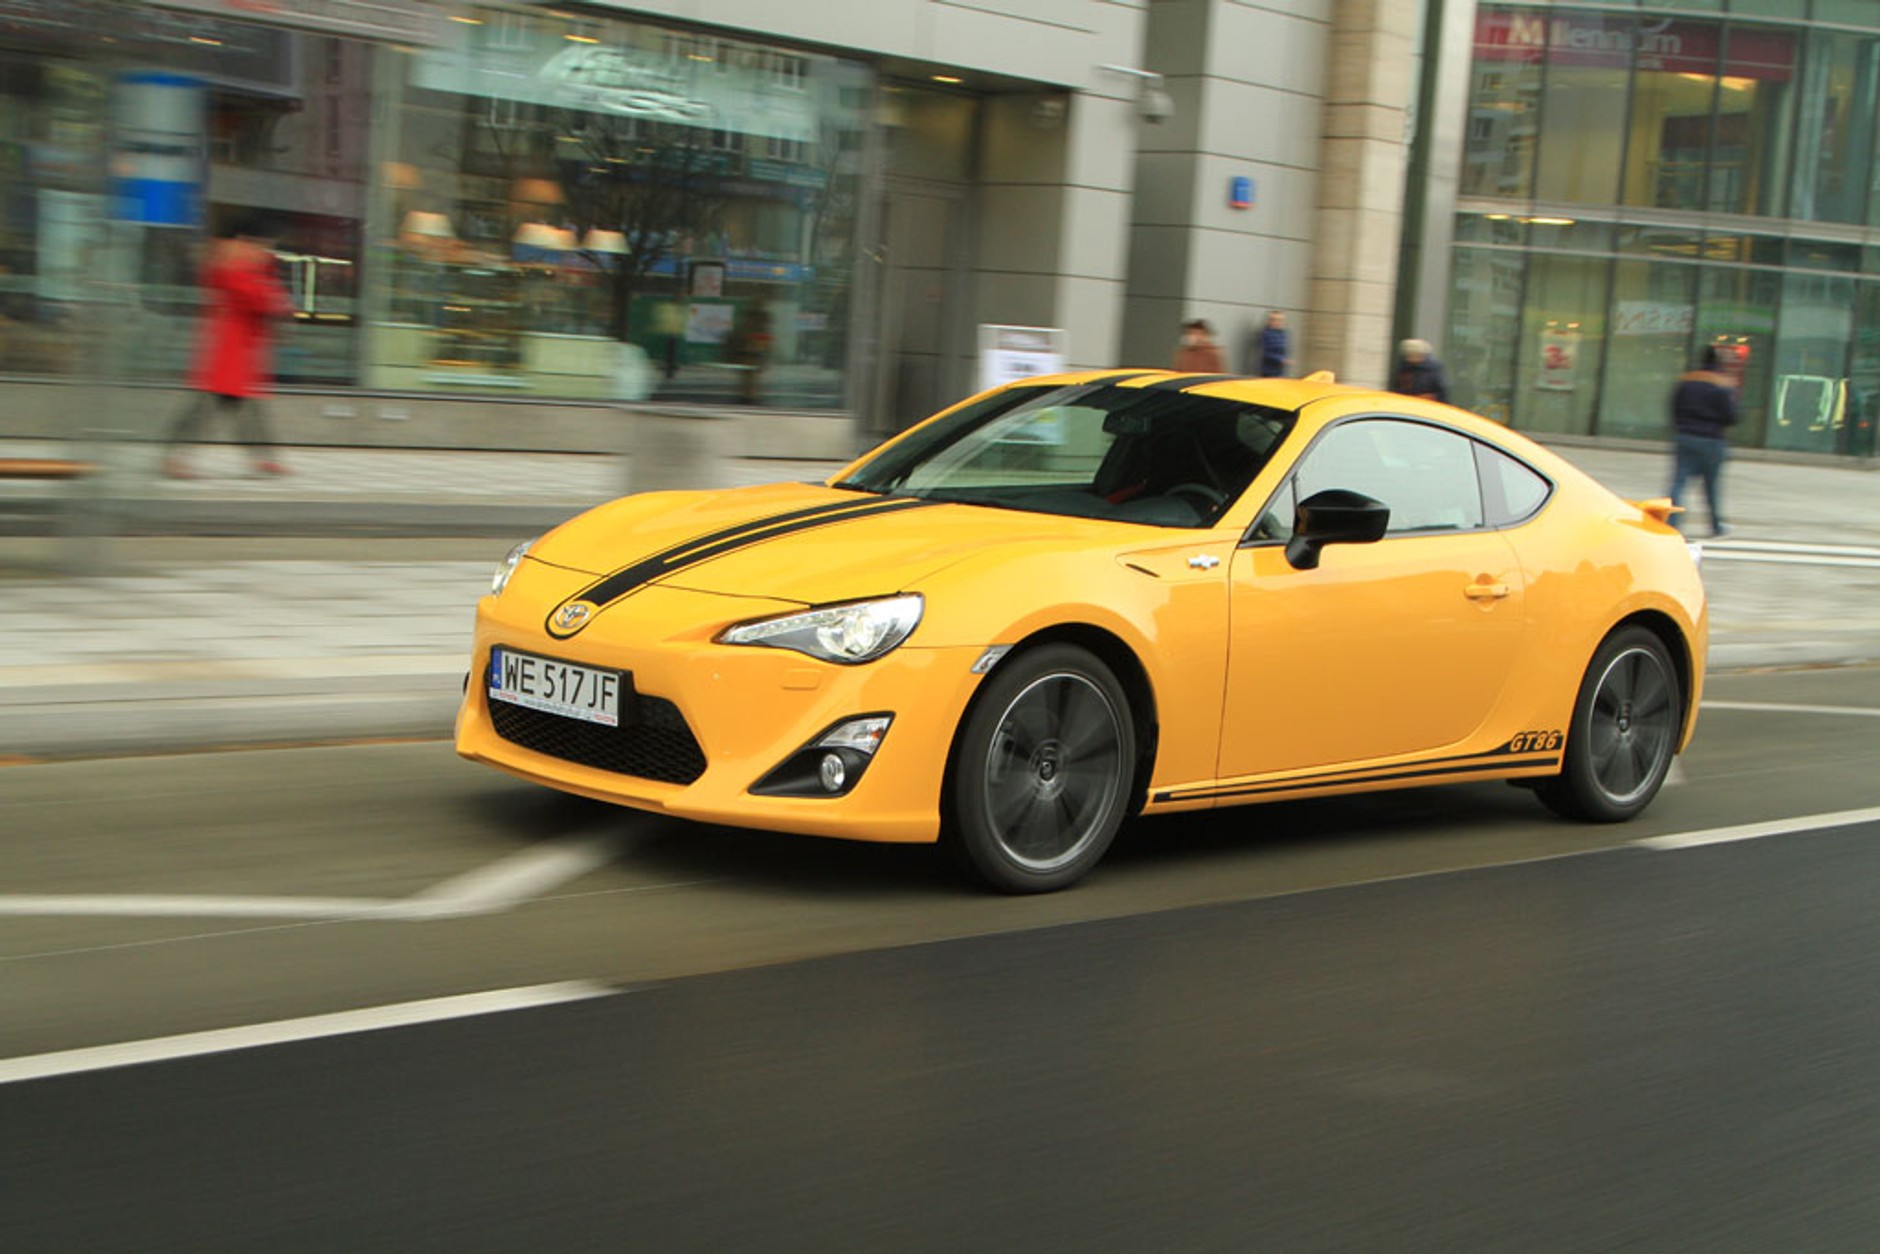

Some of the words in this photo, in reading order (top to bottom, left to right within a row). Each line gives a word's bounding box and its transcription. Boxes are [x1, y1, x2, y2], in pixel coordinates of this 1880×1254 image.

[1506, 15, 1682, 54] Mllennum
[505, 655, 535, 694] WE
[1510, 729, 1562, 752] GT86
